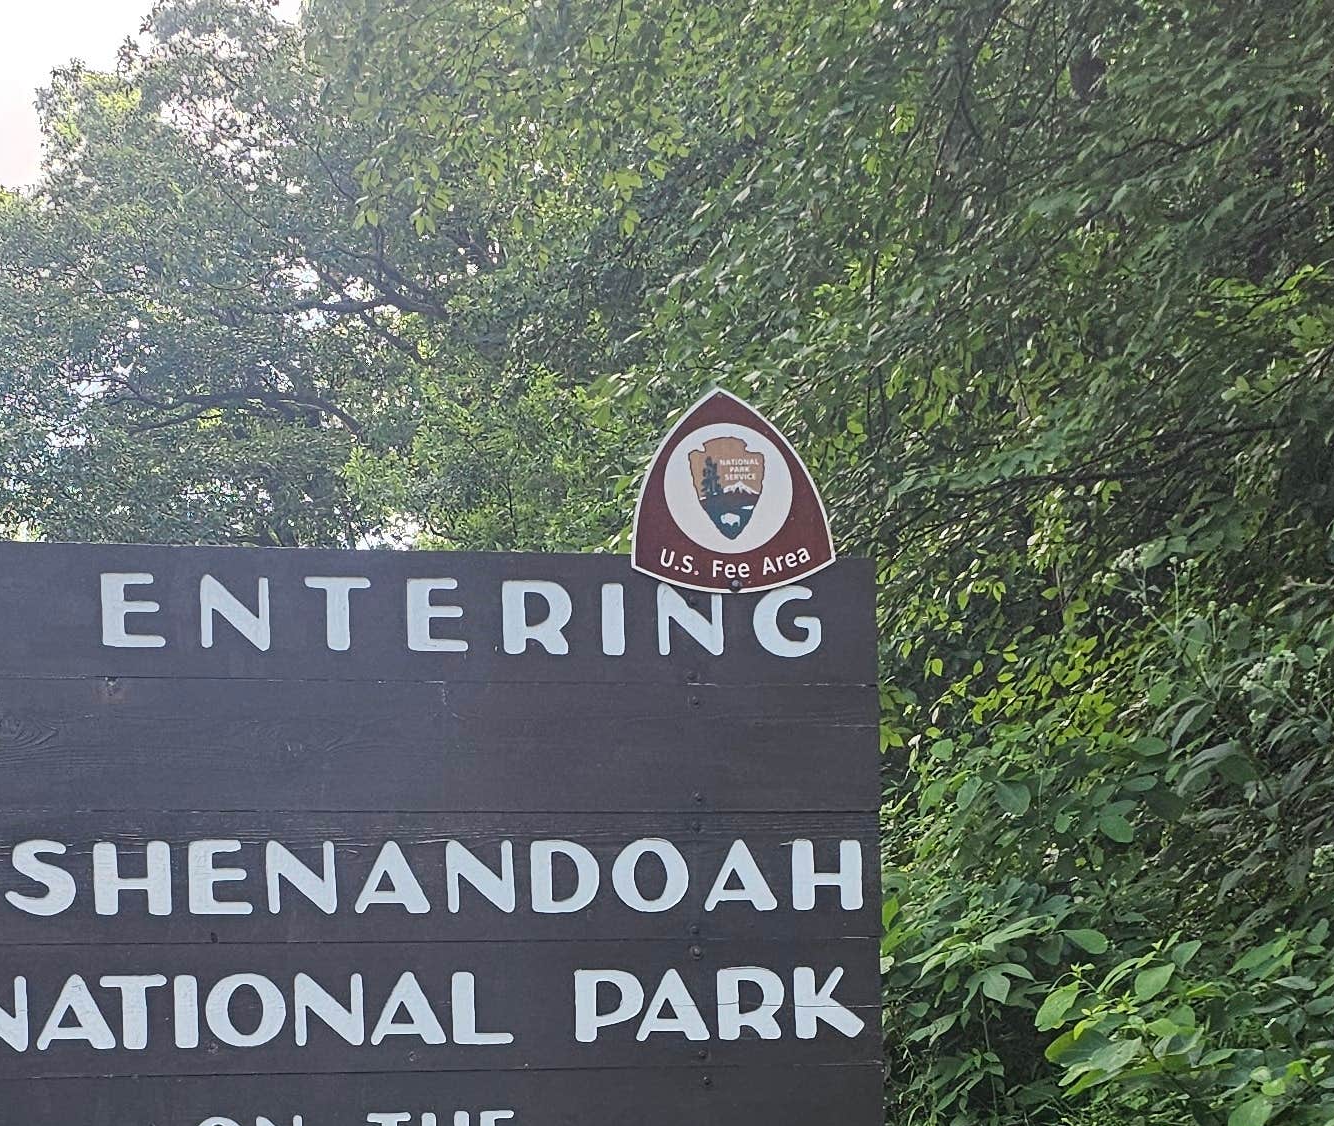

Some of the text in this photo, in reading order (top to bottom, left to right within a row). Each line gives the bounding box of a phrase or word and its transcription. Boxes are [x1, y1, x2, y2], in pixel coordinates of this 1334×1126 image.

[719, 458, 759, 467] NATIONAL
[724, 473, 757, 481] SERVICE
[729, 466, 750, 474] PARK
[660, 547, 811, 579] U.S. Fee Area
[99, 573, 822, 658] ENTERING
[4, 838, 865, 917] SHENANDOAH
[573, 965, 866, 1044] PARK
